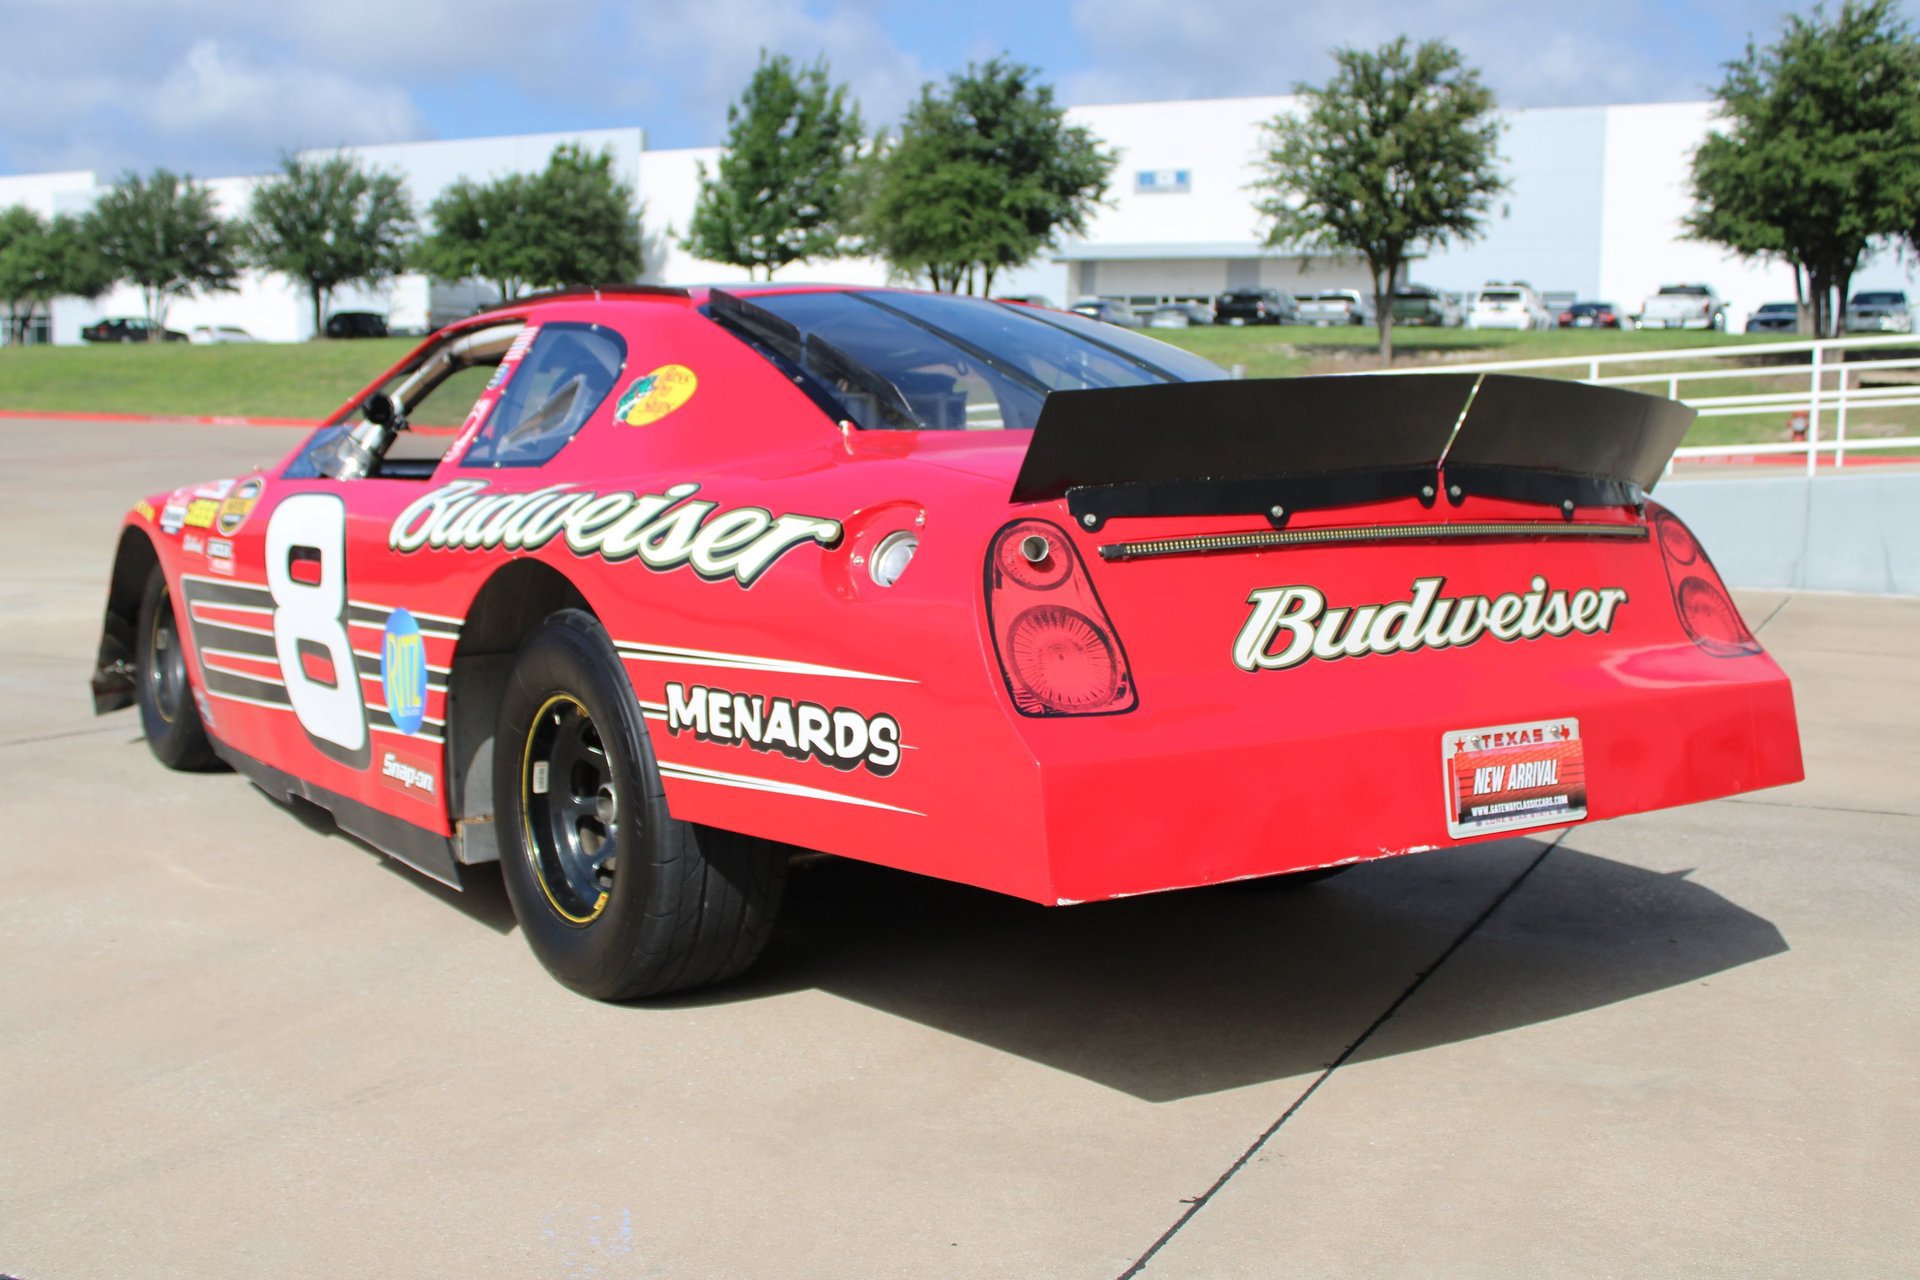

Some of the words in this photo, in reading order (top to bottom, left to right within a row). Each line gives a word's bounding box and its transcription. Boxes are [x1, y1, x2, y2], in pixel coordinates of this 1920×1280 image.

[388, 479, 843, 588] Budweiser
[264, 492, 368, 754] 8
[1232, 575, 1627, 673] Budweiser
[386, 632, 422, 717] RITZ
[382, 752, 435, 795] Snap-on
[665, 682, 901, 776] MENARDS
[1481, 728, 1544, 748] TEXAS
[1473, 765, 1506, 795] NEW
[1507, 759, 1559, 791] ARRIVAL
